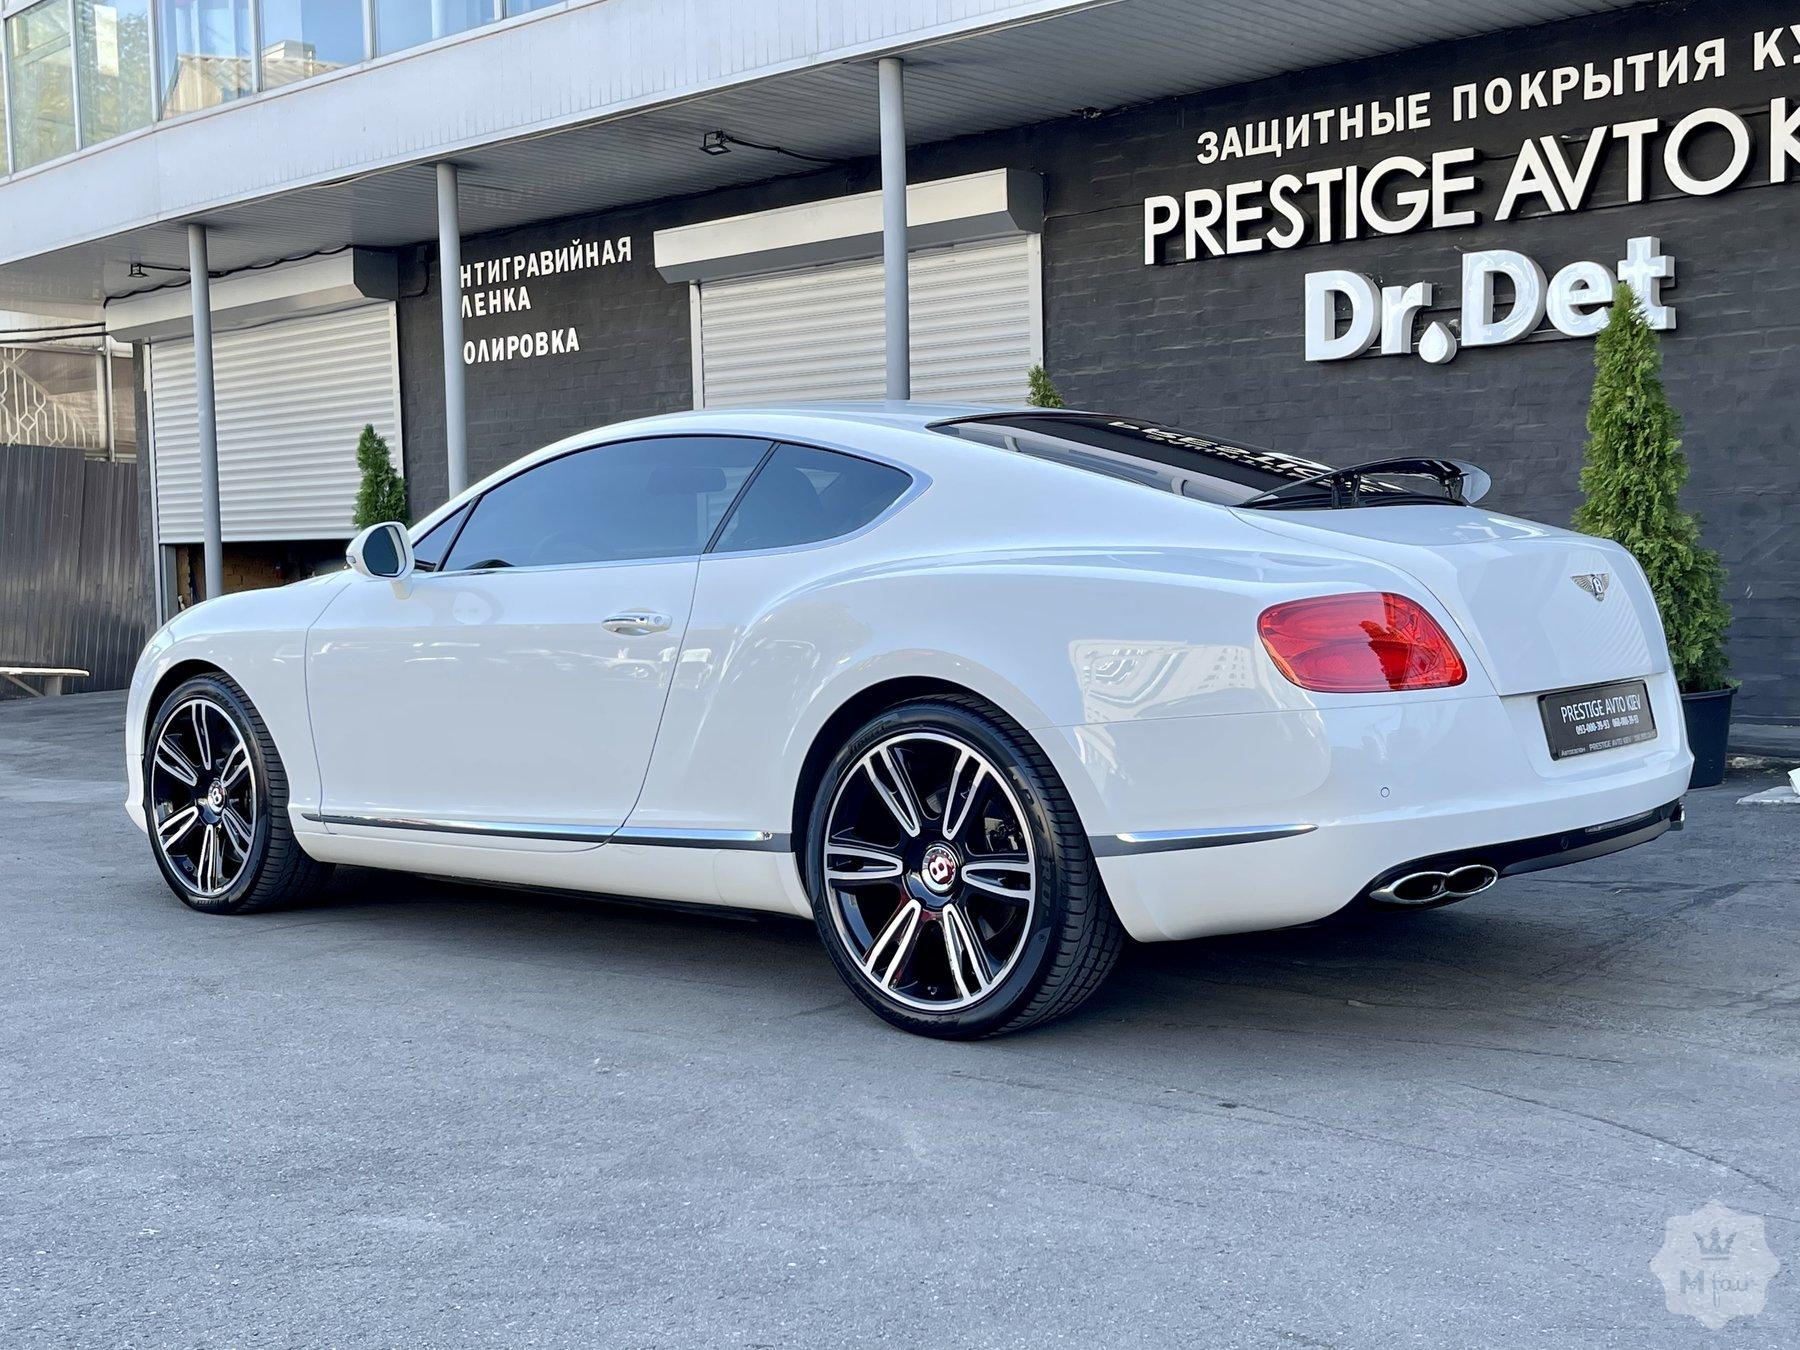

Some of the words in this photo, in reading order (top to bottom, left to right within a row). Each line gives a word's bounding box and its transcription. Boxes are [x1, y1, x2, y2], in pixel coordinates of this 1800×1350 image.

[1197, 91, 1431, 165] ЗАЩИТНЫЕ
[1453, 37, 1725, 122] ПОКРЫТИЯ
[1144, 147, 1475, 266] PRESTIGE
[460, 236, 632, 289] НТИГРАВИЙНАЯ
[461, 285, 532, 319] ЛЕНКА
[463, 327, 580, 365] ОЛИРОВКА
[1560, 699, 1605, 723] PRESTIGE
[1605, 696, 1626, 715] AVTO
[1625, 694, 1641, 711] KIEV
